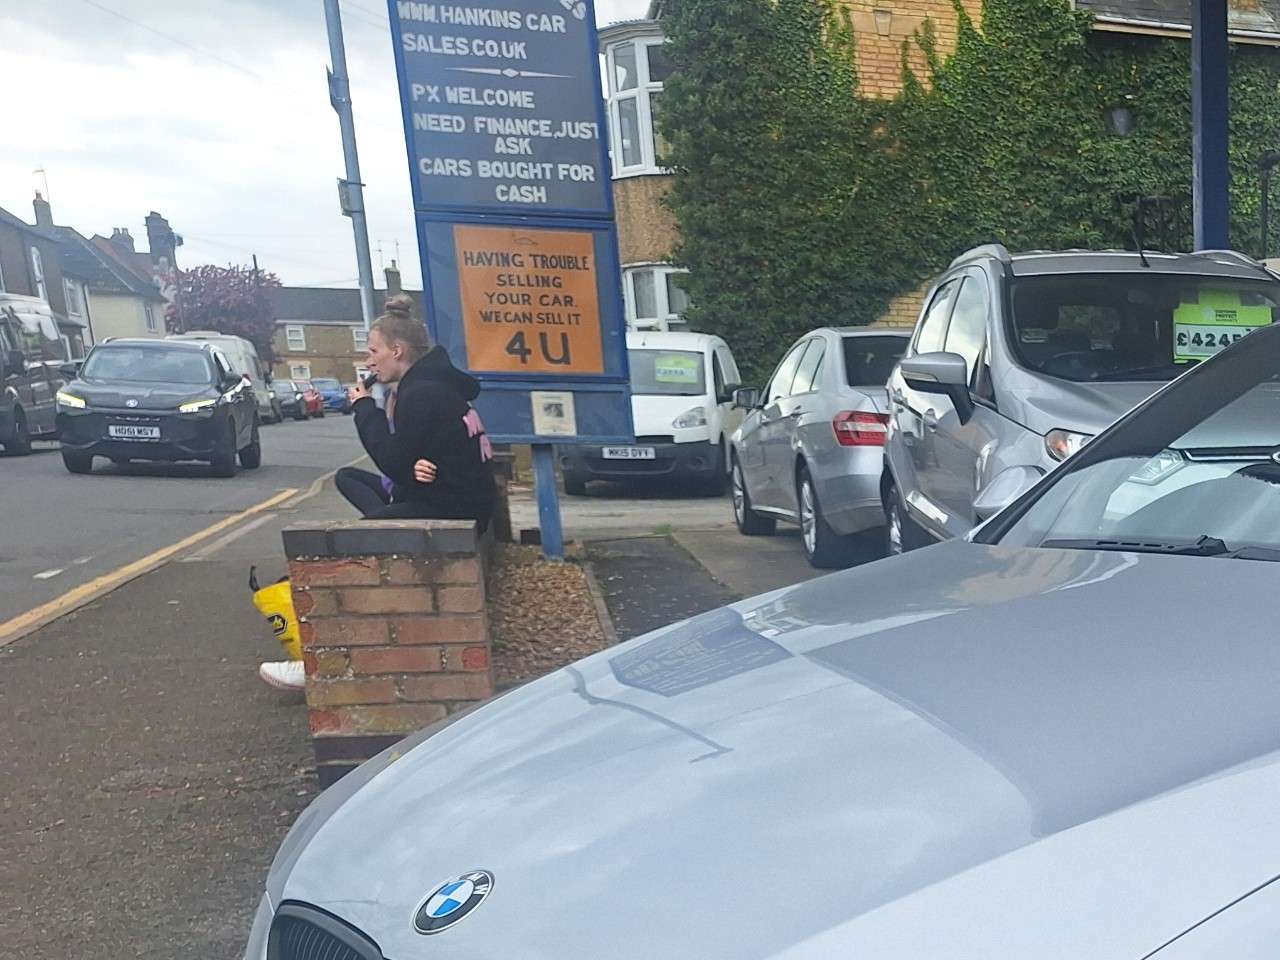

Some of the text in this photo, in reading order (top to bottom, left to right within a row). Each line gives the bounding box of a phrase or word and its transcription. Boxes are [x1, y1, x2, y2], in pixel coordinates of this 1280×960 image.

[397, 1, 567, 33] WWW.HANKINS CAR
[402, 33, 527, 60] SALES.CO.UK
[412, 84, 535, 108] PX WELCOME
[414, 113, 465, 133] NEED
[495, 137, 532, 154] ASK
[419, 158, 595, 182] CARS BOUGHT FOR
[496, 185, 547, 203] CASH
[464, 250, 590, 271] HAVING TROUBLE
[496, 273, 562, 288] SELLING
[484, 292, 532, 305] YOUR
[504, 311, 533, 324] CAN
[536, 313, 565, 325] SELL
[567, 313, 582, 325] IT
[505, 330, 571, 366] 4 U
